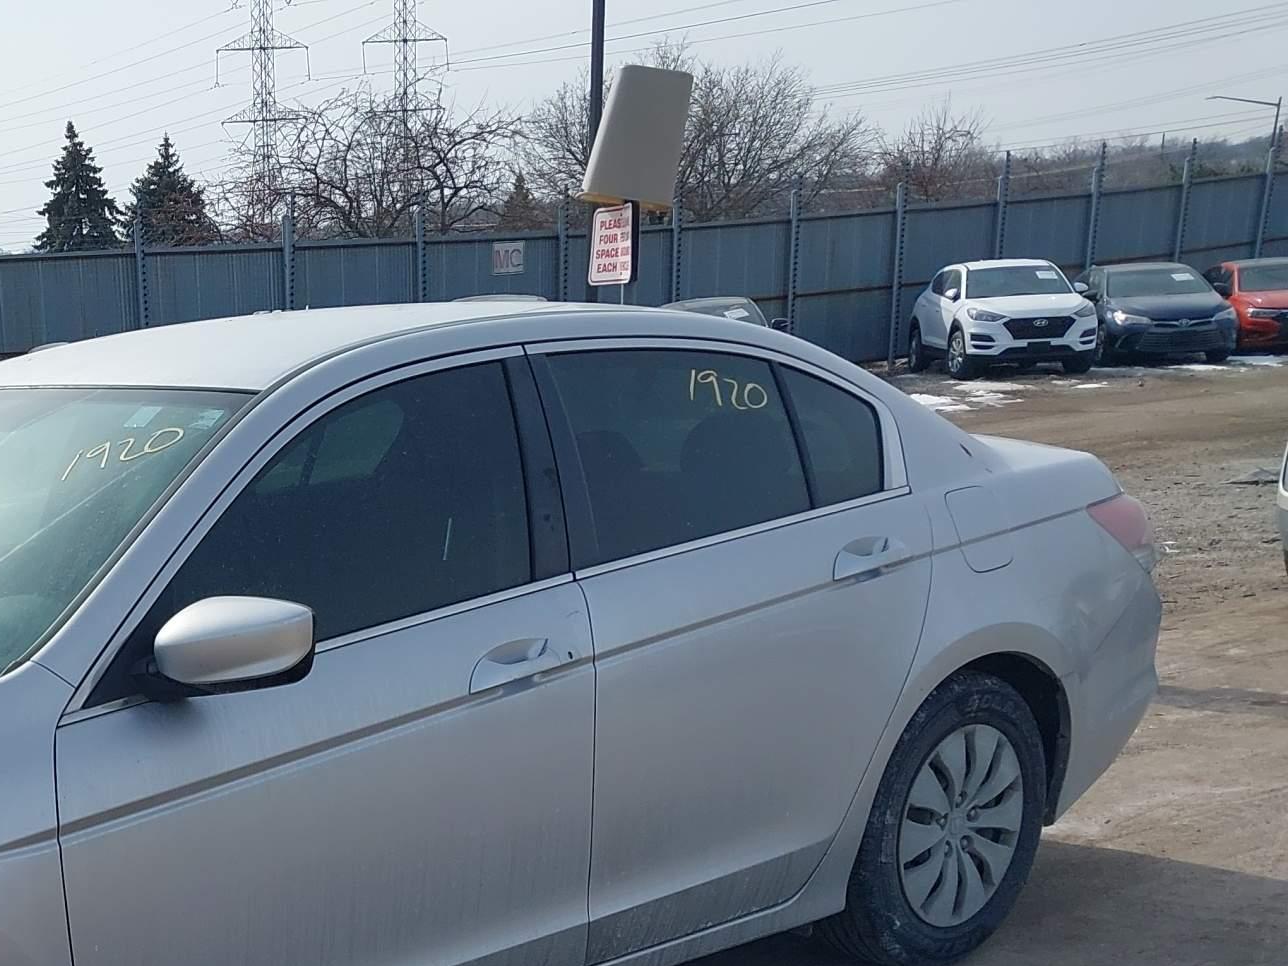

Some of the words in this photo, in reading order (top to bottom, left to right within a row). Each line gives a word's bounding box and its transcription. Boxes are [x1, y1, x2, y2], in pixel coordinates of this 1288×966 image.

[600, 233, 618, 245] FOUR
[495, 248, 523, 269] MC
[596, 247, 619, 260] SPACE
[597, 262, 618, 274] EACH
[690, 369, 768, 410] 1920
[62, 427, 185, 481] 1920
